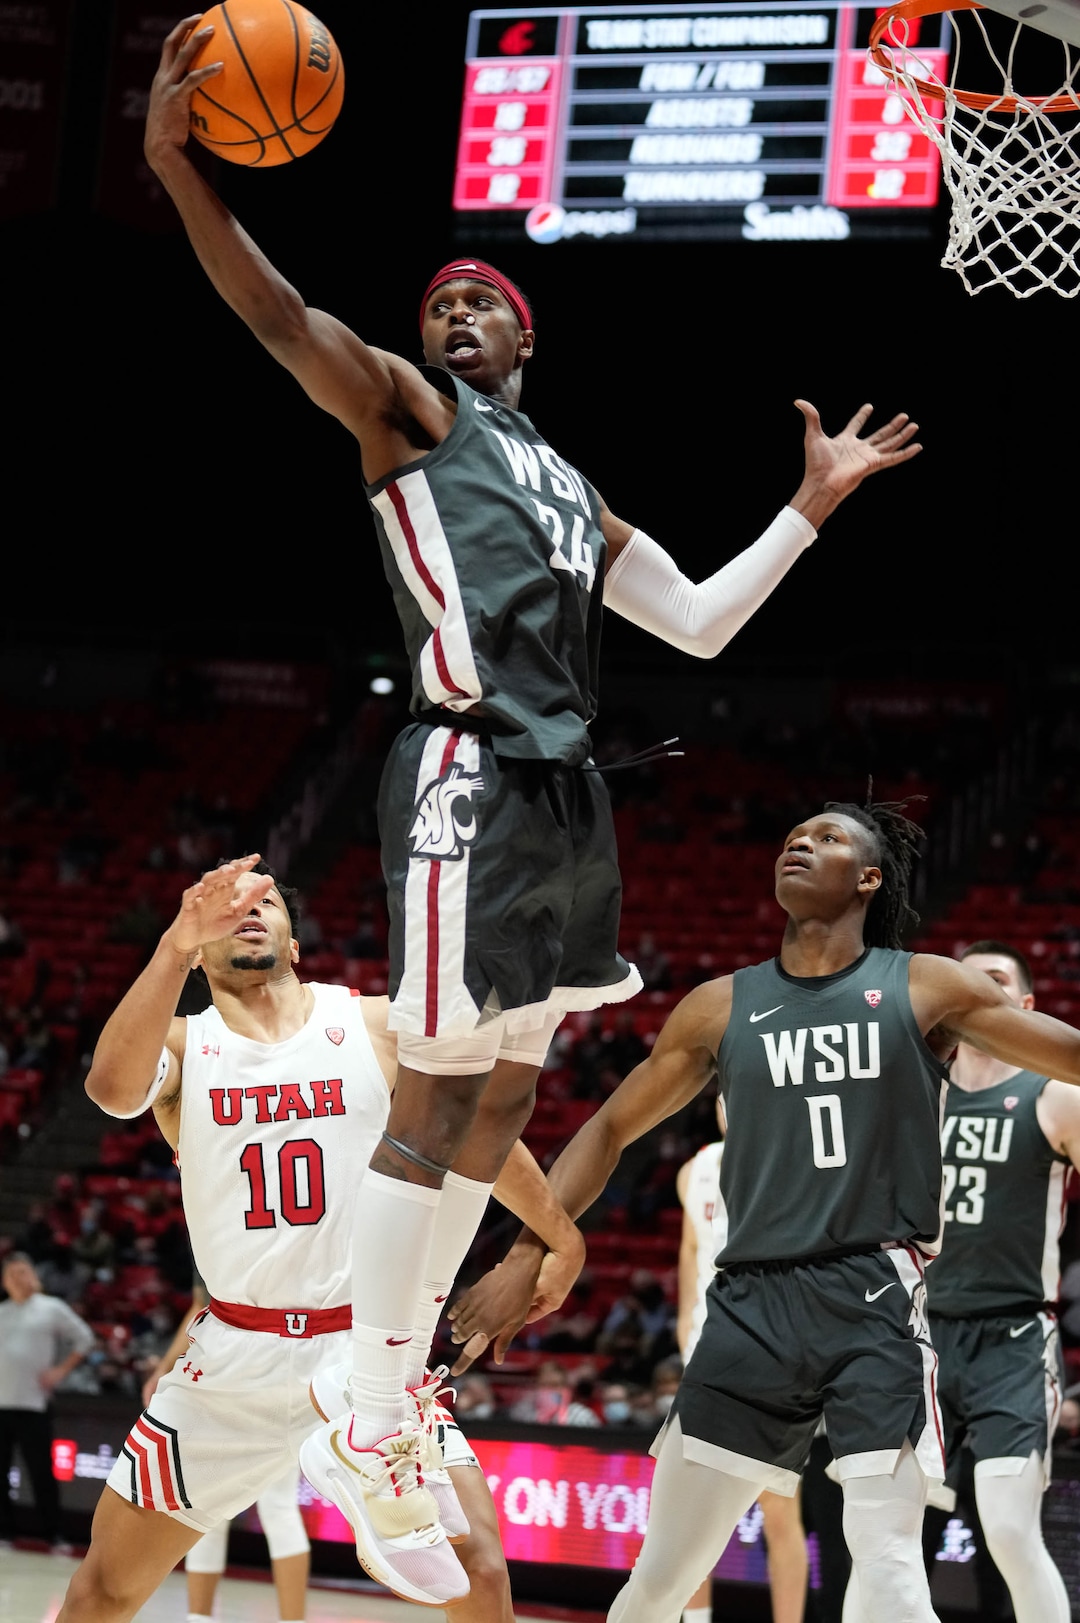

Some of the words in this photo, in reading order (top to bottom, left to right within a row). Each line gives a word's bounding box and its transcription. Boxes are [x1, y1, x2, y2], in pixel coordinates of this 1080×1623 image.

[488, 429, 592, 521] WSU
[530, 498, 596, 593] 24
[759, 1022, 881, 1088] WSU
[209, 1079, 346, 1126] UTAH
[804, 1094, 847, 1169] 0
[240, 1138, 326, 1230] 10
[942, 1165, 987, 1225] 23
[284, 1312, 308, 1336] U
[504, 1476, 569, 1529] ON
